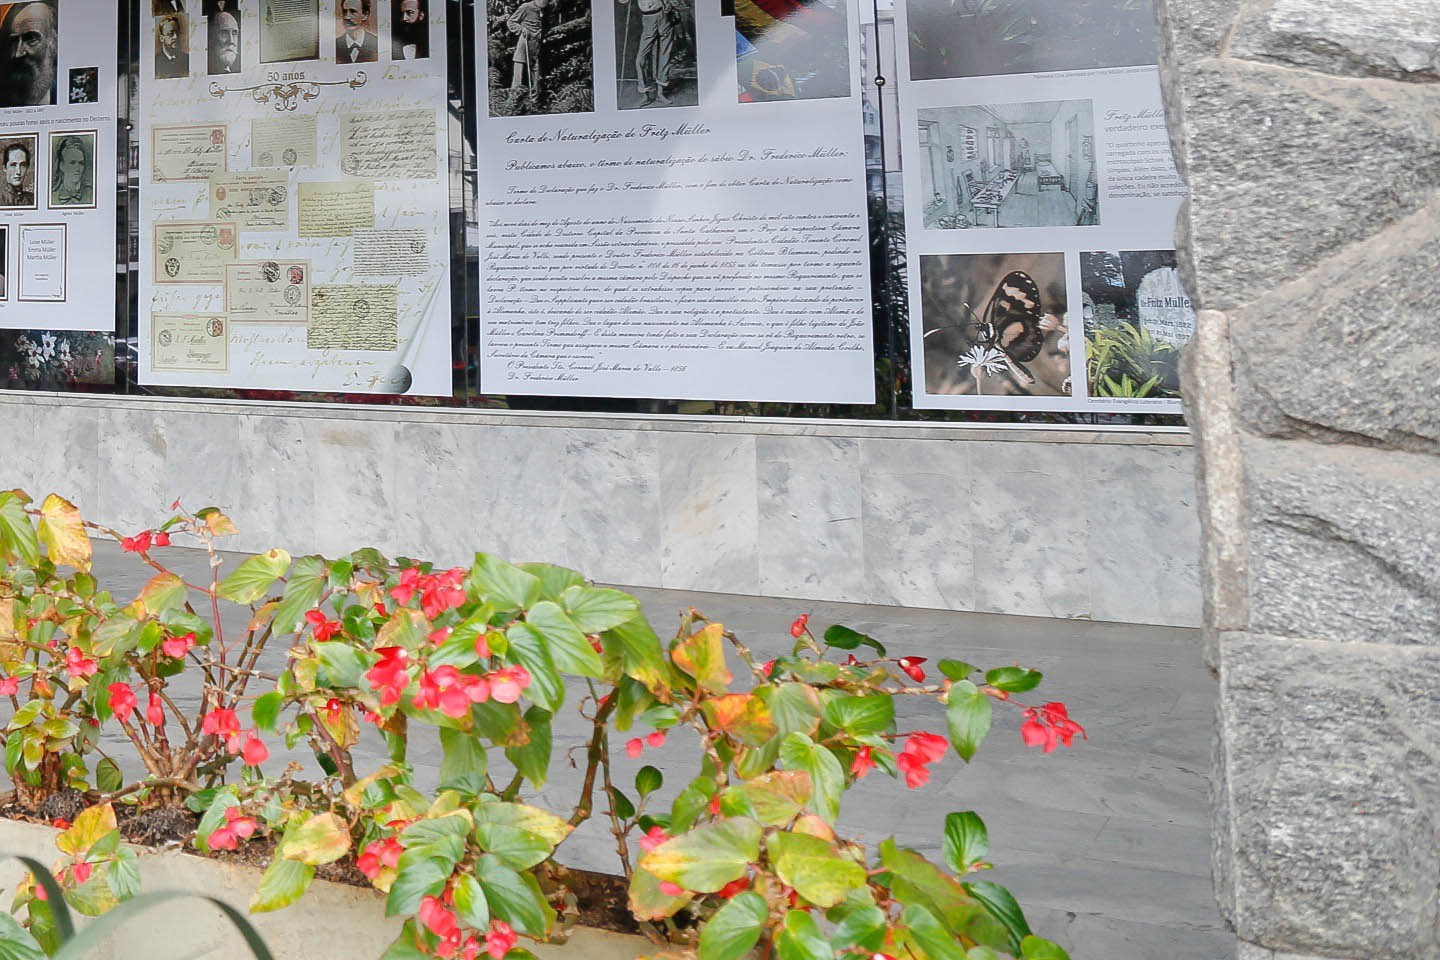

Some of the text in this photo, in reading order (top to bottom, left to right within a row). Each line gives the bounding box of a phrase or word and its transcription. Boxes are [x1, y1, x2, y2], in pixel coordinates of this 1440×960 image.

[267, 72, 305, 82] 50 anos
[1104, 108, 1164, 123] Fritz Mülle
[505, 123, 711, 144] Carta de Naturalização de Fritz Müller
[1104, 124, 1148, 132] verdadeiro
[505, 160, 556, 171] Publicamos
[557, 159, 587, 169] abaixo,
[623, 157, 633, 166] de
[635, 155, 696, 167] naturalização
[710, 152, 734, 162] sábio
[760, 148, 807, 161] Frederico
[538, 185, 575, 194] Declaração
[622, 182, 655, 191] Frederico
[749, 177, 770, 186] Carta
[780, 176, 834, 186] Naturalização
[1147, 297, 1163, 308] Fritz
[1164, 296, 1192, 308] Mülle
[513, 361, 550, 370] Presidente
[568, 362, 595, 370] Coronel
[523, 372, 554, 381] Frederico
[554, 373, 579, 381] Müller
